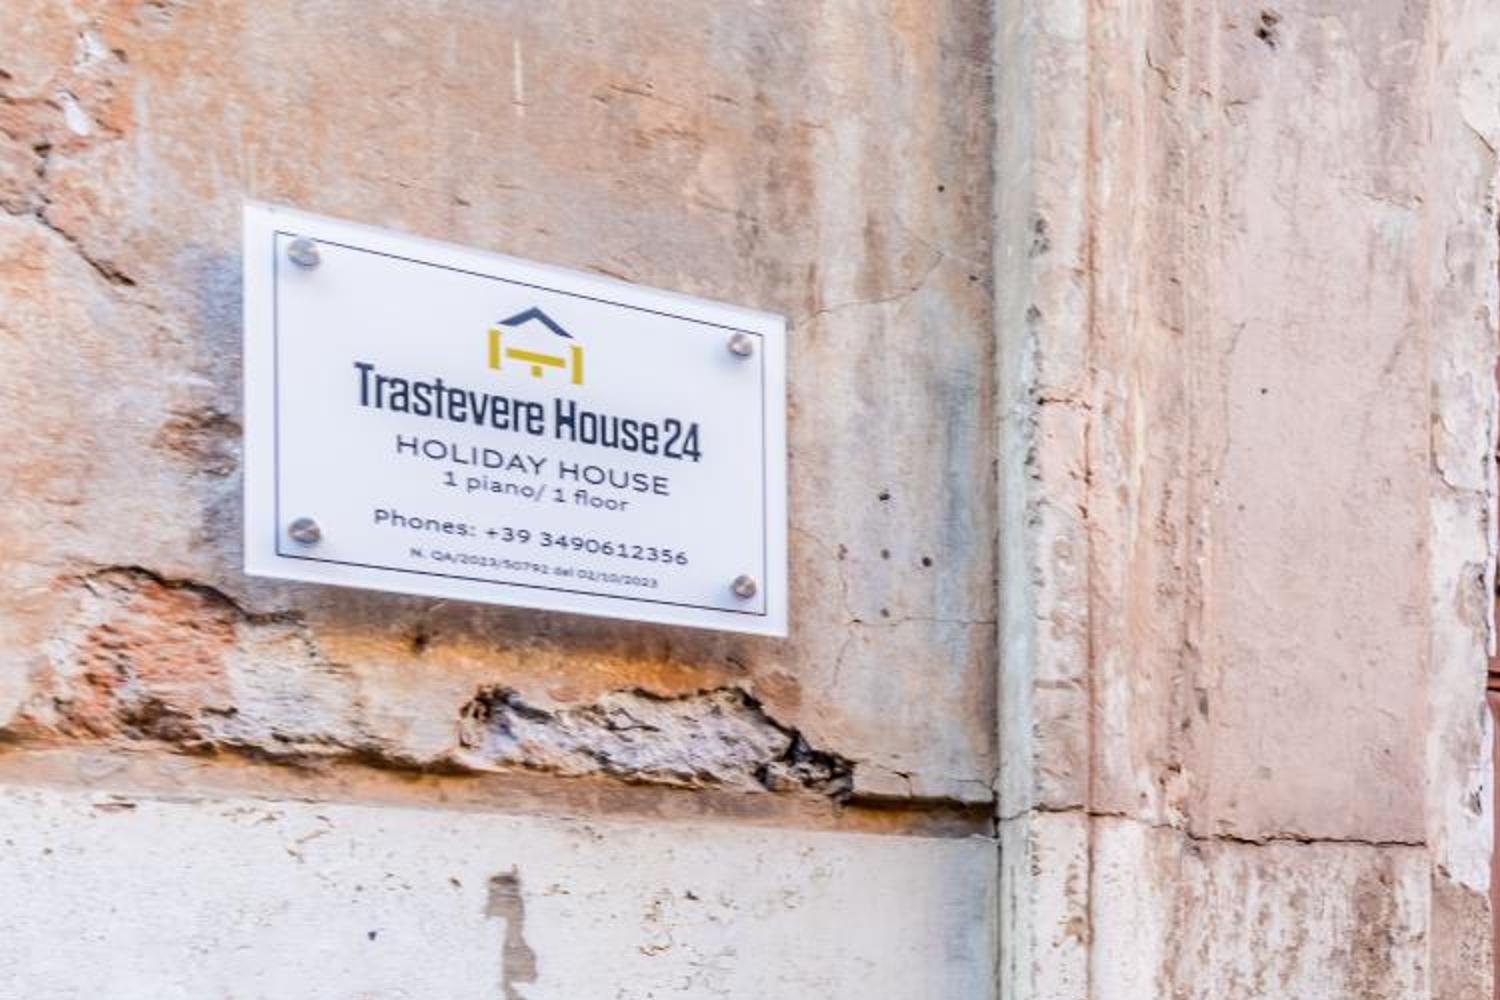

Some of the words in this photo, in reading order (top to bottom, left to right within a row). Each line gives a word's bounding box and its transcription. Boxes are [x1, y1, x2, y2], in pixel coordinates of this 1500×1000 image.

[353, 361, 545, 436] Trastevere
[554, 397, 702, 462] House24
[396, 434, 547, 475] HOLIDAY
[559, 460, 670, 496] HOUSE
[444, 471, 458, 487] 1
[466, 475, 547, 501] piano/
[553, 488, 566, 503] 1
[573, 489, 630, 511] floor
[373, 508, 477, 537] Phones:
[485, 527, 531, 543] +39
[539, 531, 688, 565] 3490612356
